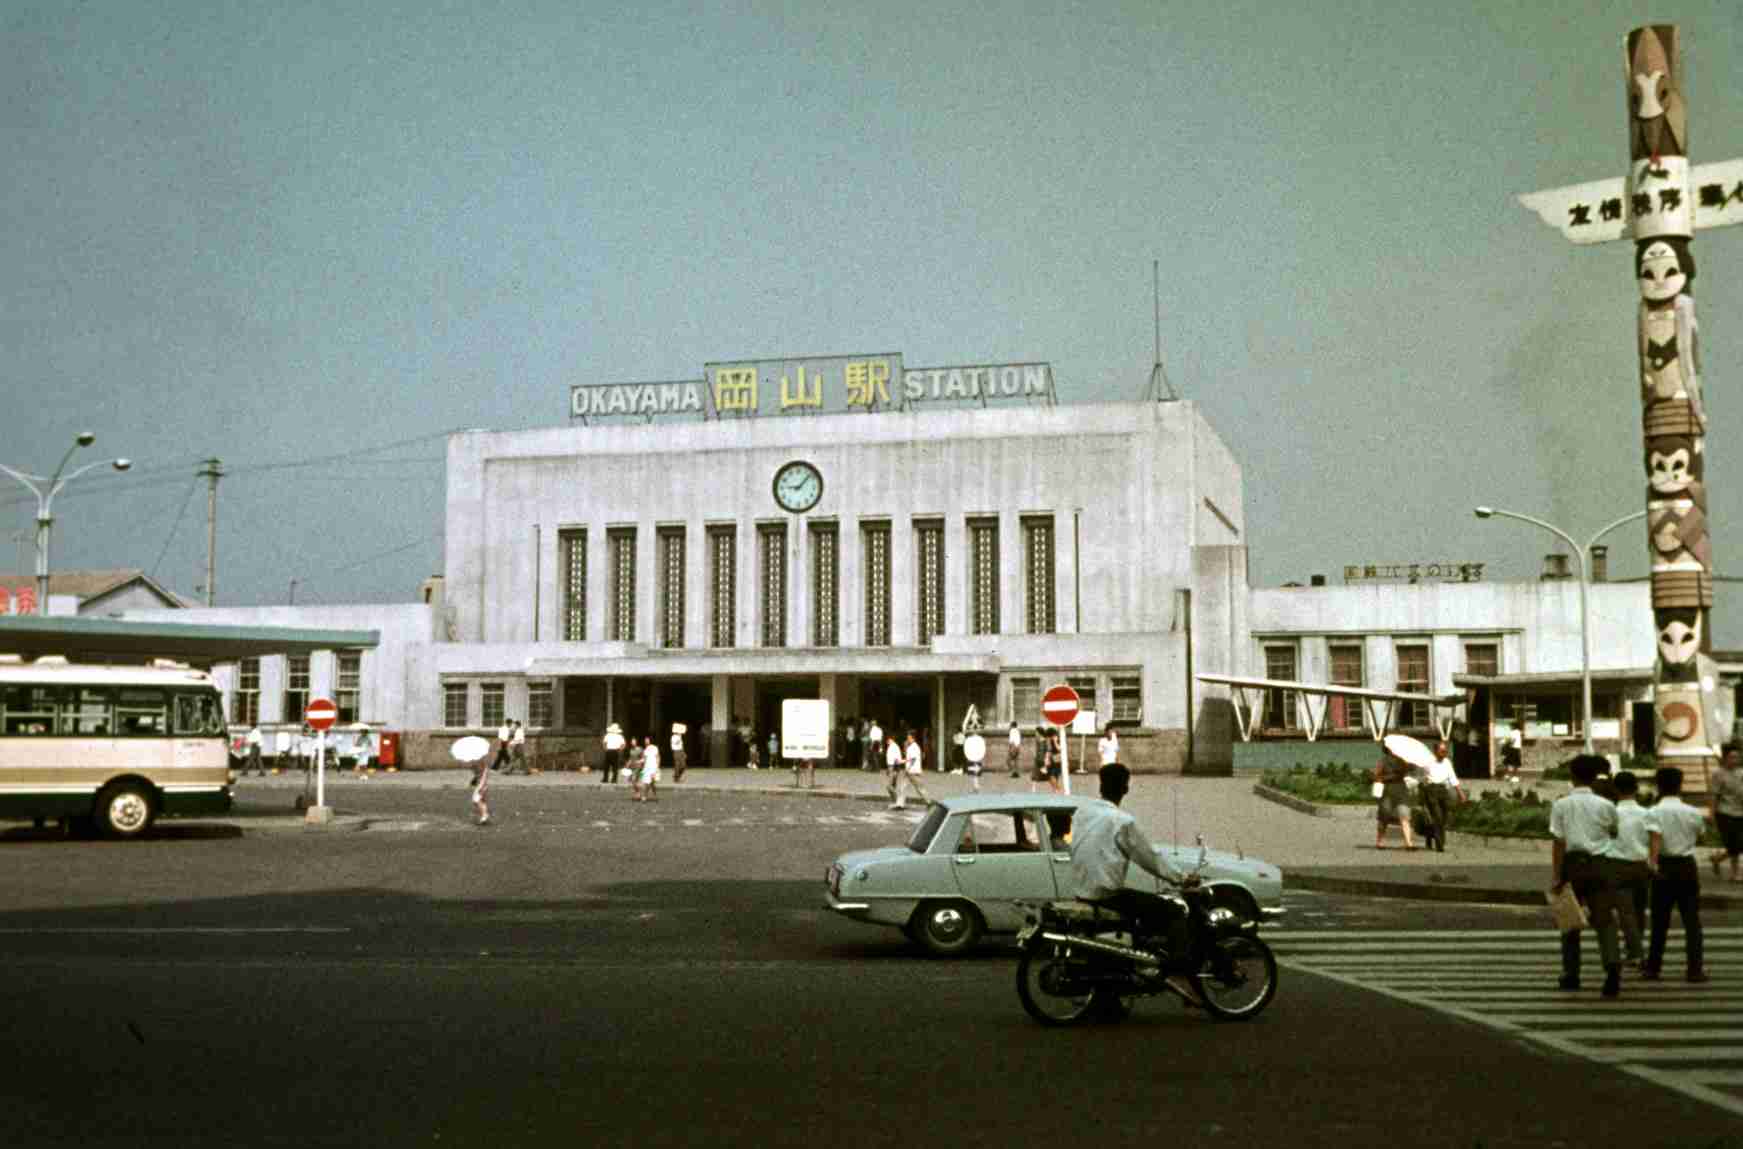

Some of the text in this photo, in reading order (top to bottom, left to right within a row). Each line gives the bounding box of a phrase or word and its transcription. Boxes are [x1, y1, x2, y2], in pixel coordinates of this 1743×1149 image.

[572, 381, 701, 415] OKAYAMA
[716, 359, 891, 411] 岡山駅
[903, 365, 1048, 400] STATION
